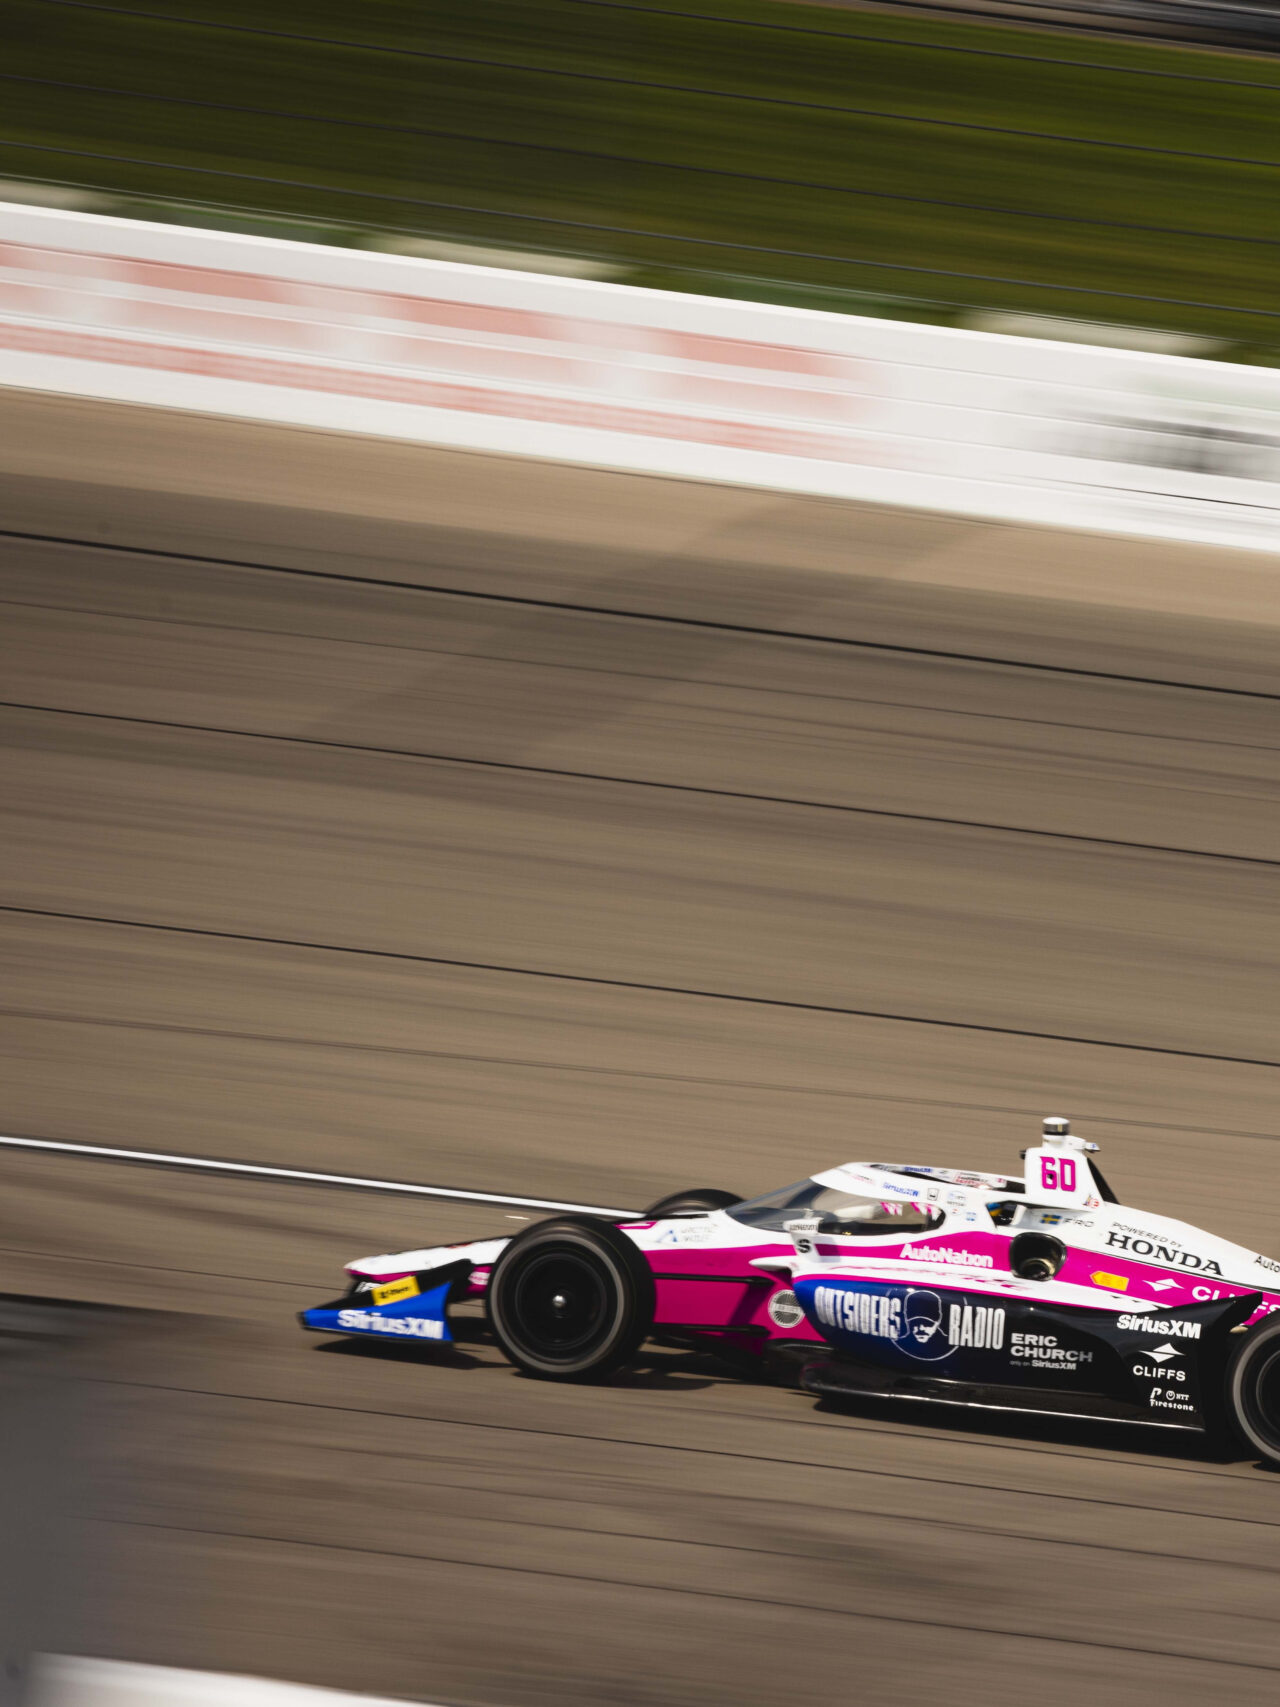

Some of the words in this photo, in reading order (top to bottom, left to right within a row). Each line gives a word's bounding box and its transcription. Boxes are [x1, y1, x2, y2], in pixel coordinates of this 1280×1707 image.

[1040, 1156, 1076, 1192] 60
[900, 1243, 994, 1269] AutoNation
[1105, 1231, 1224, 1277] HONDA
[337, 1309, 444, 1340] SiriusXM
[814, 1286, 901, 1338] OUTSIDERS
[948, 1304, 1006, 1350] RADIO
[1116, 1314, 1202, 1339] SiriusXM
[1011, 1332, 1058, 1347] ERIC
[1010, 1345, 1093, 1362] CHURCH
[1031, 1359, 1077, 1371] SiriusXM
[1132, 1365, 1186, 1381] CLIFFS
[1150, 1398, 1194, 1412] Firestone
[1175, 1393, 1190, 1401] NTT
